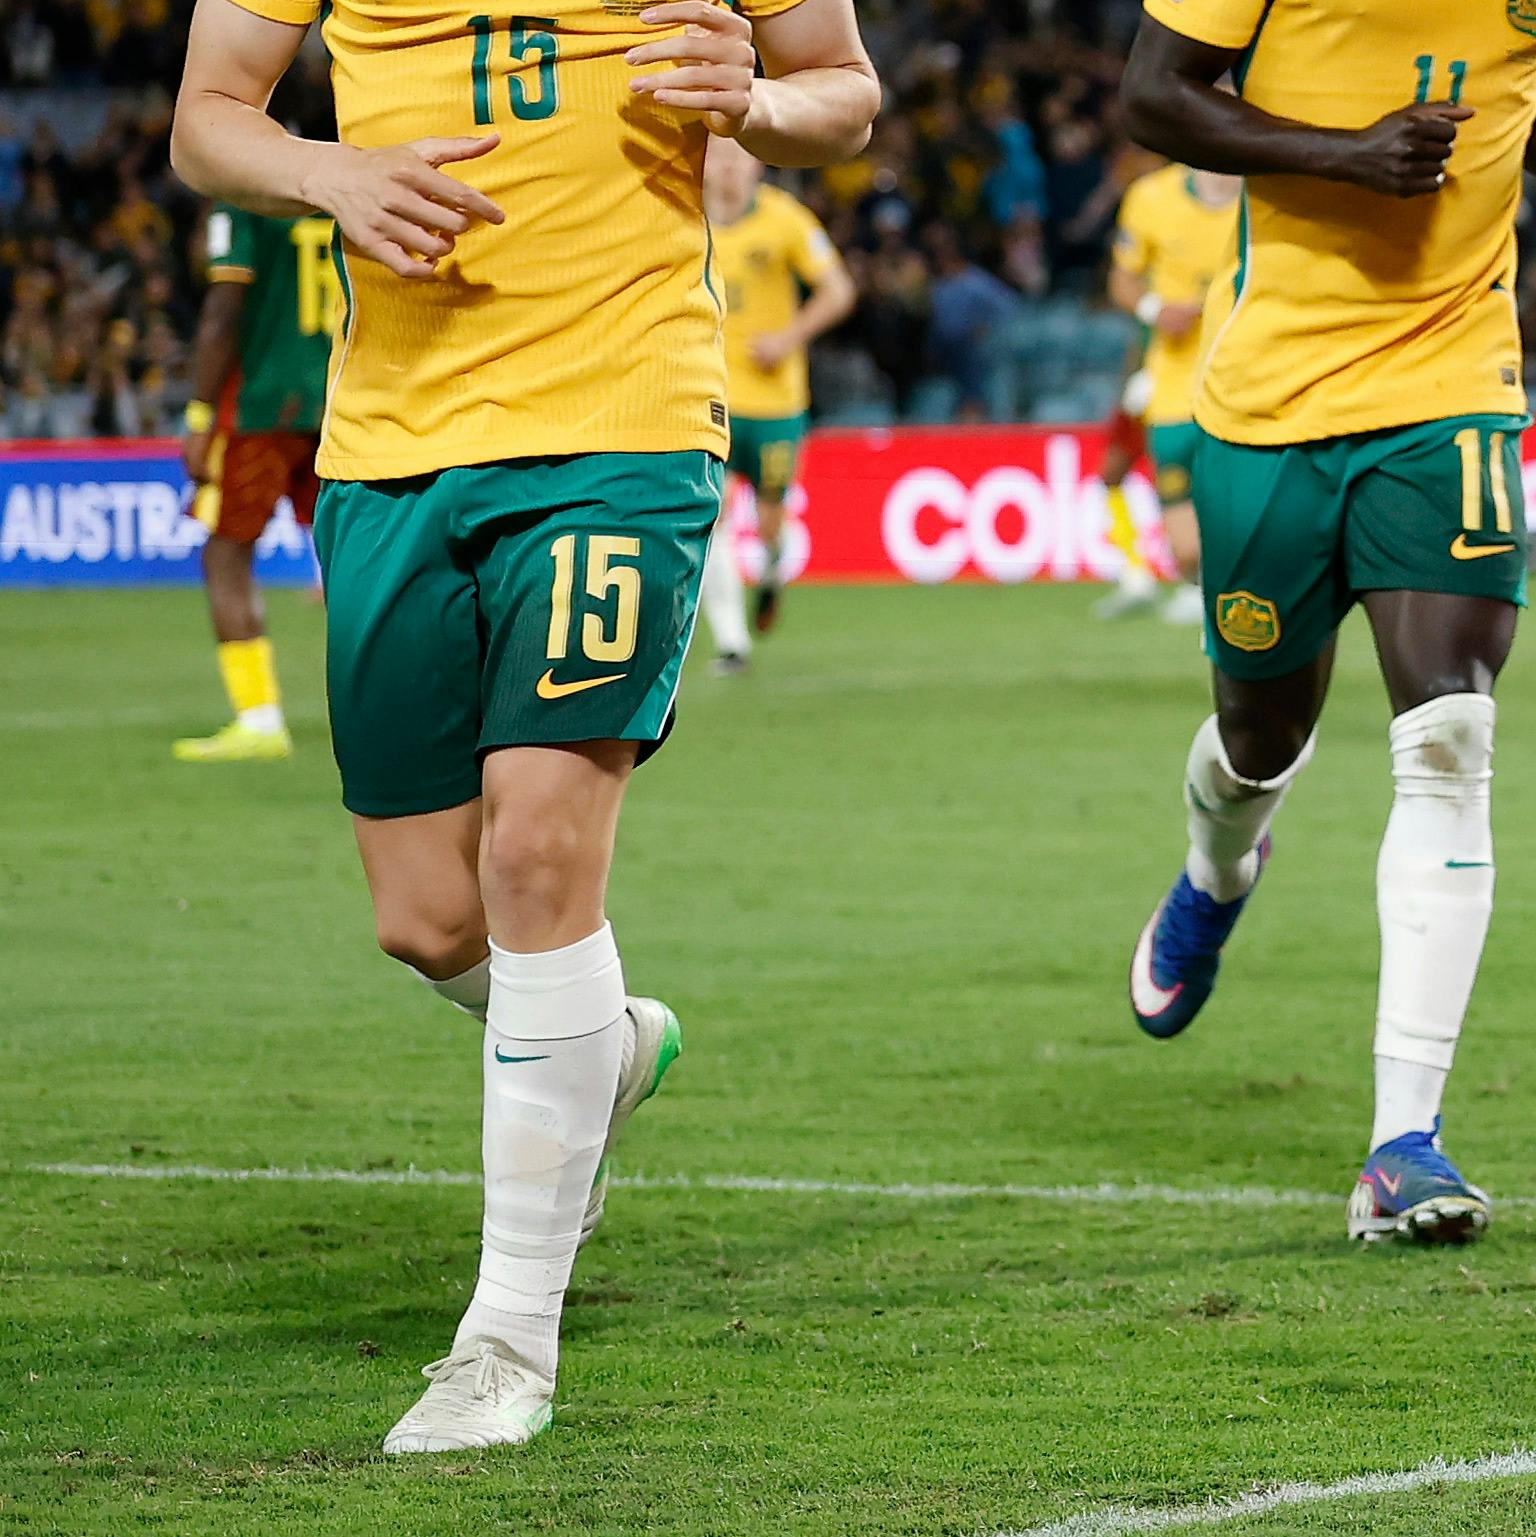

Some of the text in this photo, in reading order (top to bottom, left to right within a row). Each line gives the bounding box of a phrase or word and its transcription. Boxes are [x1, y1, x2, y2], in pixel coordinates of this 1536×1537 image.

[467, 13, 559, 126] 15
[1452, 427, 1515, 536] 11
[547, 534, 641, 664] 15
